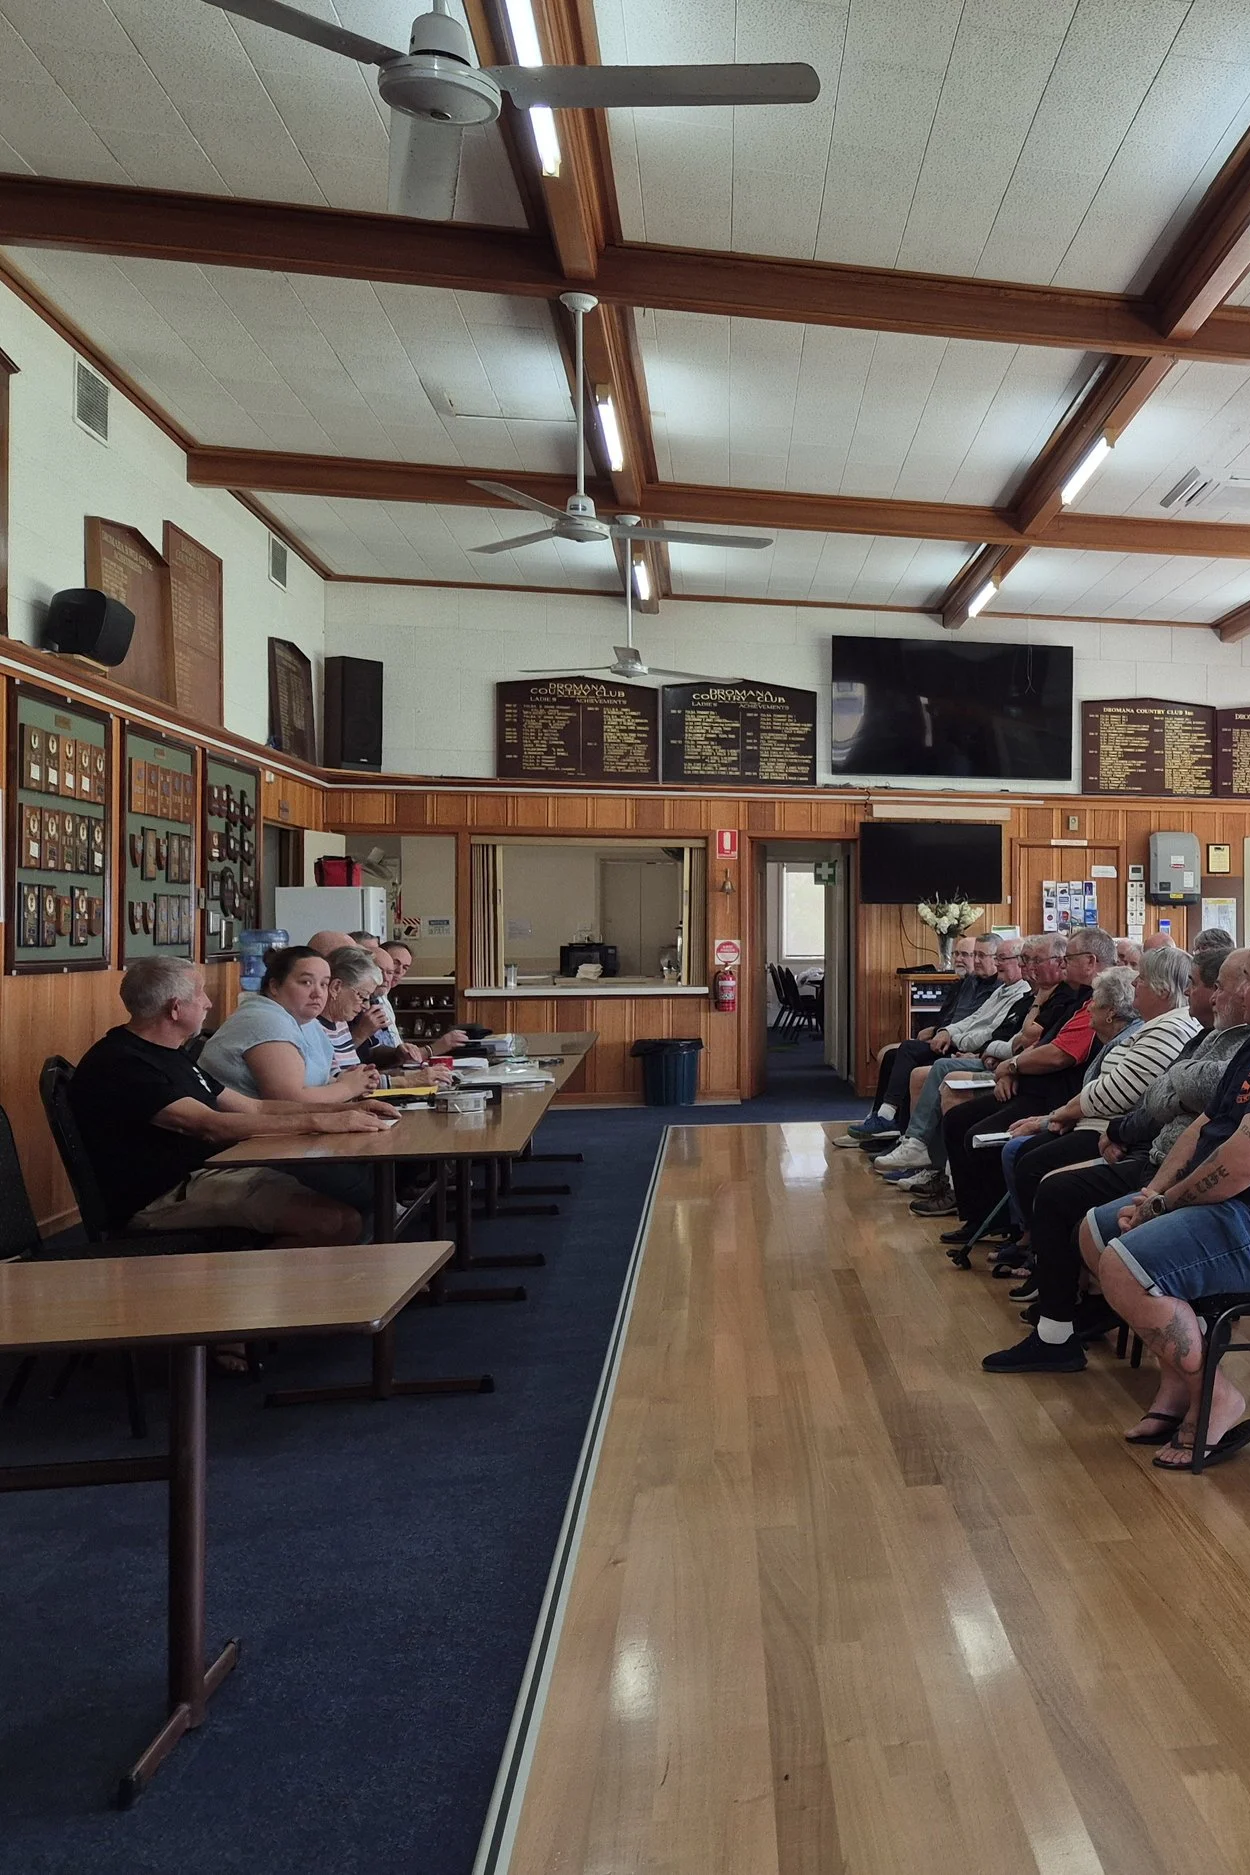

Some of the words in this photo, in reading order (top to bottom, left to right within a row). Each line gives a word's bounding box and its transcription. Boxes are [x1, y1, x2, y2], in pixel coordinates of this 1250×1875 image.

[550, 683, 605, 692] DROMANA
[531, 688, 591, 697] COUNTRY
[596, 690, 625, 698] CLUB
[709, 688, 772, 697] DROMANA
[757, 696, 785, 704] CLUB
[1103, 706, 1135, 714] DROMANA
